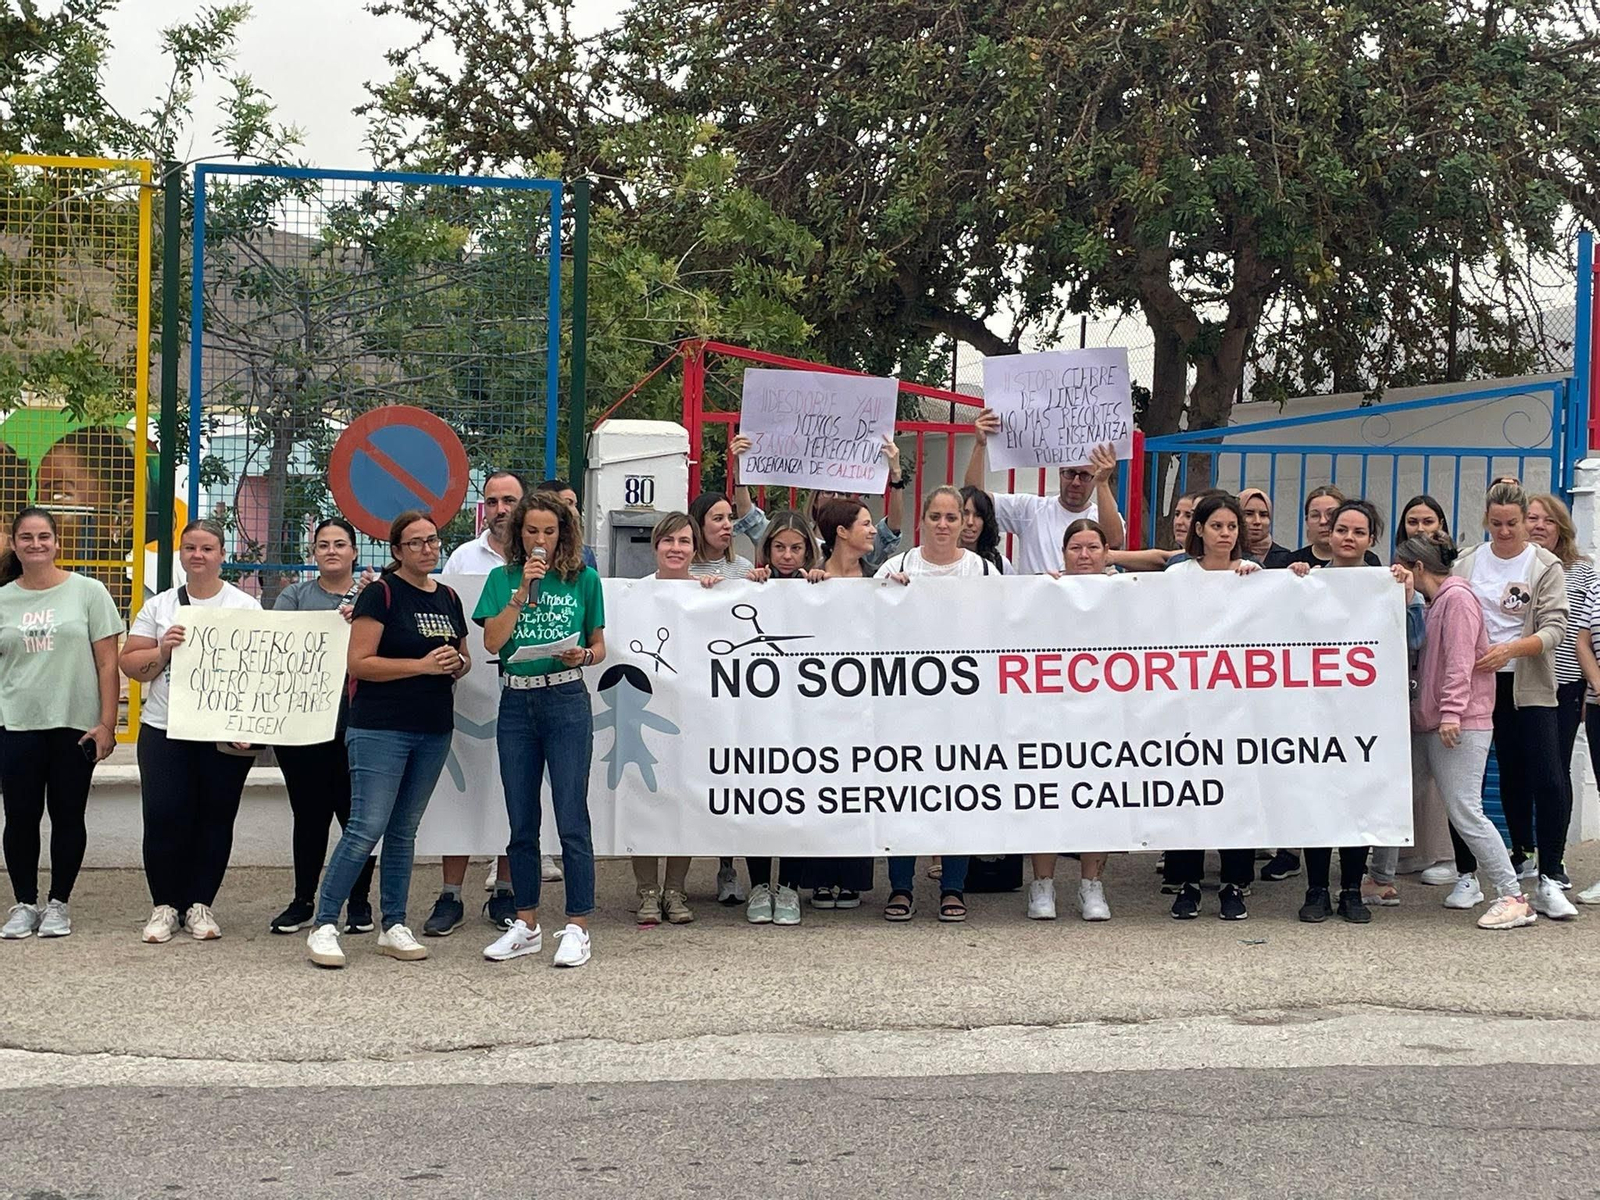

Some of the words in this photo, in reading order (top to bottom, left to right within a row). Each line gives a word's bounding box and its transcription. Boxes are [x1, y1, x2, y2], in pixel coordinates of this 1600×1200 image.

[1020, 390, 1037, 410] DE
[1000, 410, 1018, 433] NO
[1061, 401, 1123, 430] RECORTES
[854, 419, 877, 443] DE
[1006, 430, 1023, 449] EN
[1032, 424, 1048, 448] LA
[752, 433, 764, 455] 3
[809, 460, 824, 476] DE
[826, 462, 876, 481] CALIDAD
[625, 478, 654, 504] 80
[22, 609, 55, 625] ONE
[22, 636, 54, 653] TIME
[188, 626, 220, 650] NO
[231, 628, 296, 654] QUIERO
[304, 631, 330, 654] QUE
[199, 648, 227, 670] ME
[190, 667, 249, 695] QUIERO
[257, 670, 332, 695] ESTUDIAR
[711, 658, 780, 698] NO
[797, 655, 980, 697] SOMOS
[999, 646, 1377, 694] RECORTABLES
[197, 689, 246, 712] DONDE
[251, 691, 281, 713] MIS
[287, 690, 335, 714] PADRES
[224, 714, 287, 735] ELIGEN
[709, 746, 839, 775] UNIDOS
[852, 745, 924, 773] POR
[935, 744, 1008, 772] UNA
[1018, 732, 1224, 770] EDUCACIÓN
[1237, 736, 1347, 765] DIGNA
[1354, 735, 1378, 762] Y
[708, 787, 806, 815] UNOS
[817, 783, 1002, 814] SERVICIOS
[1014, 782, 1059, 810] DE
[1071, 779, 1225, 809] CALIDAD
